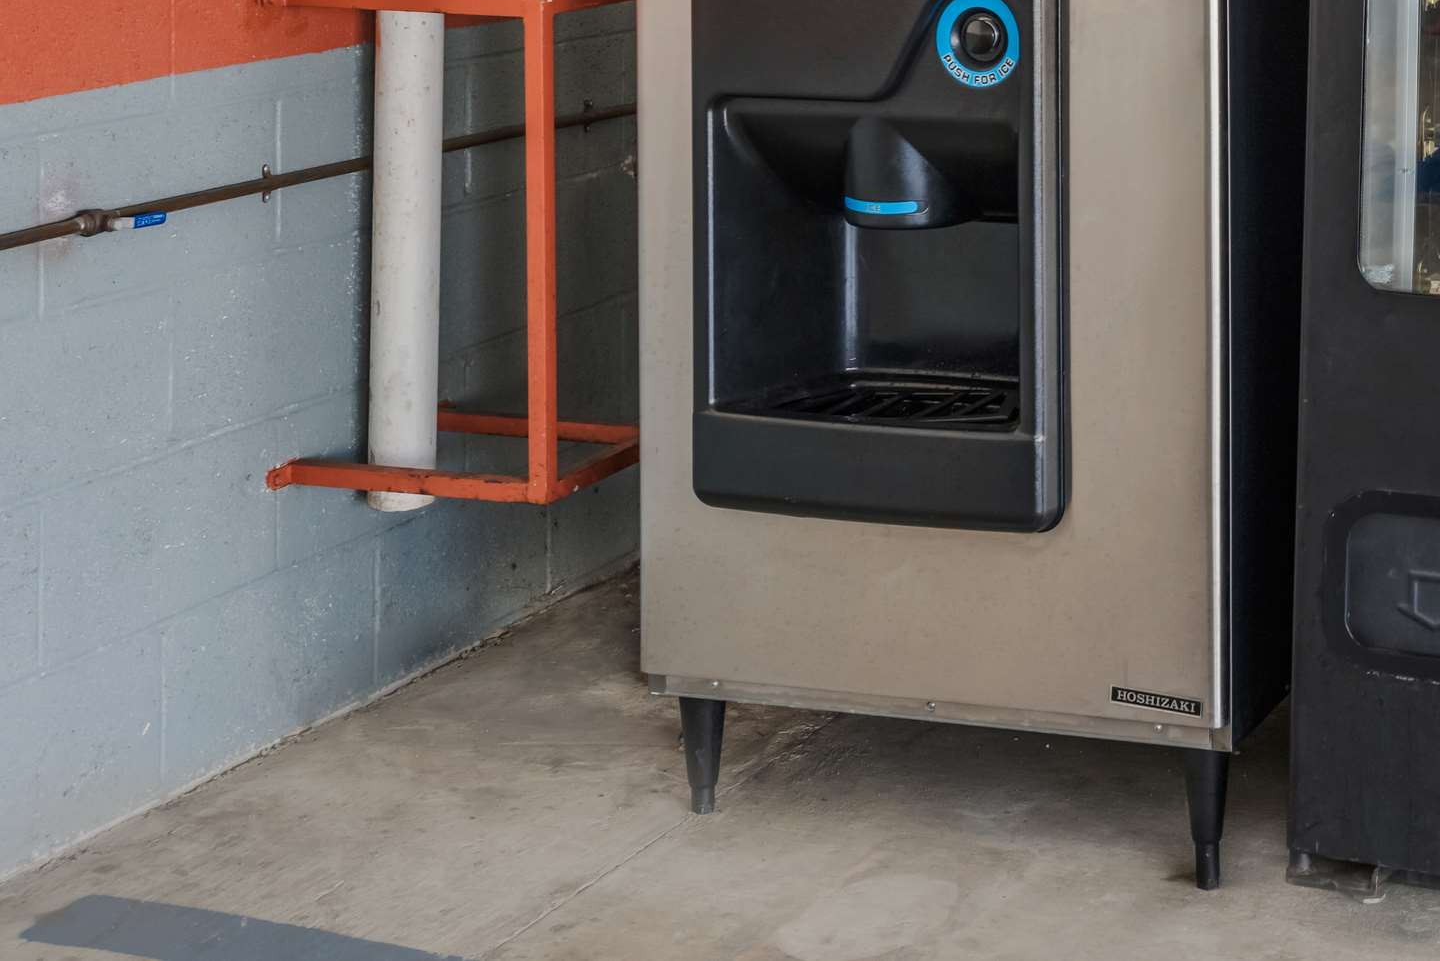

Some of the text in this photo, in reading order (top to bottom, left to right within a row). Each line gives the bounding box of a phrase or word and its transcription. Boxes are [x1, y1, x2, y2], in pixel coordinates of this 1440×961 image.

[942, 53, 1015, 85] PUSH FOR ICE
[1117, 689, 1197, 713] HOSHIZAKI
